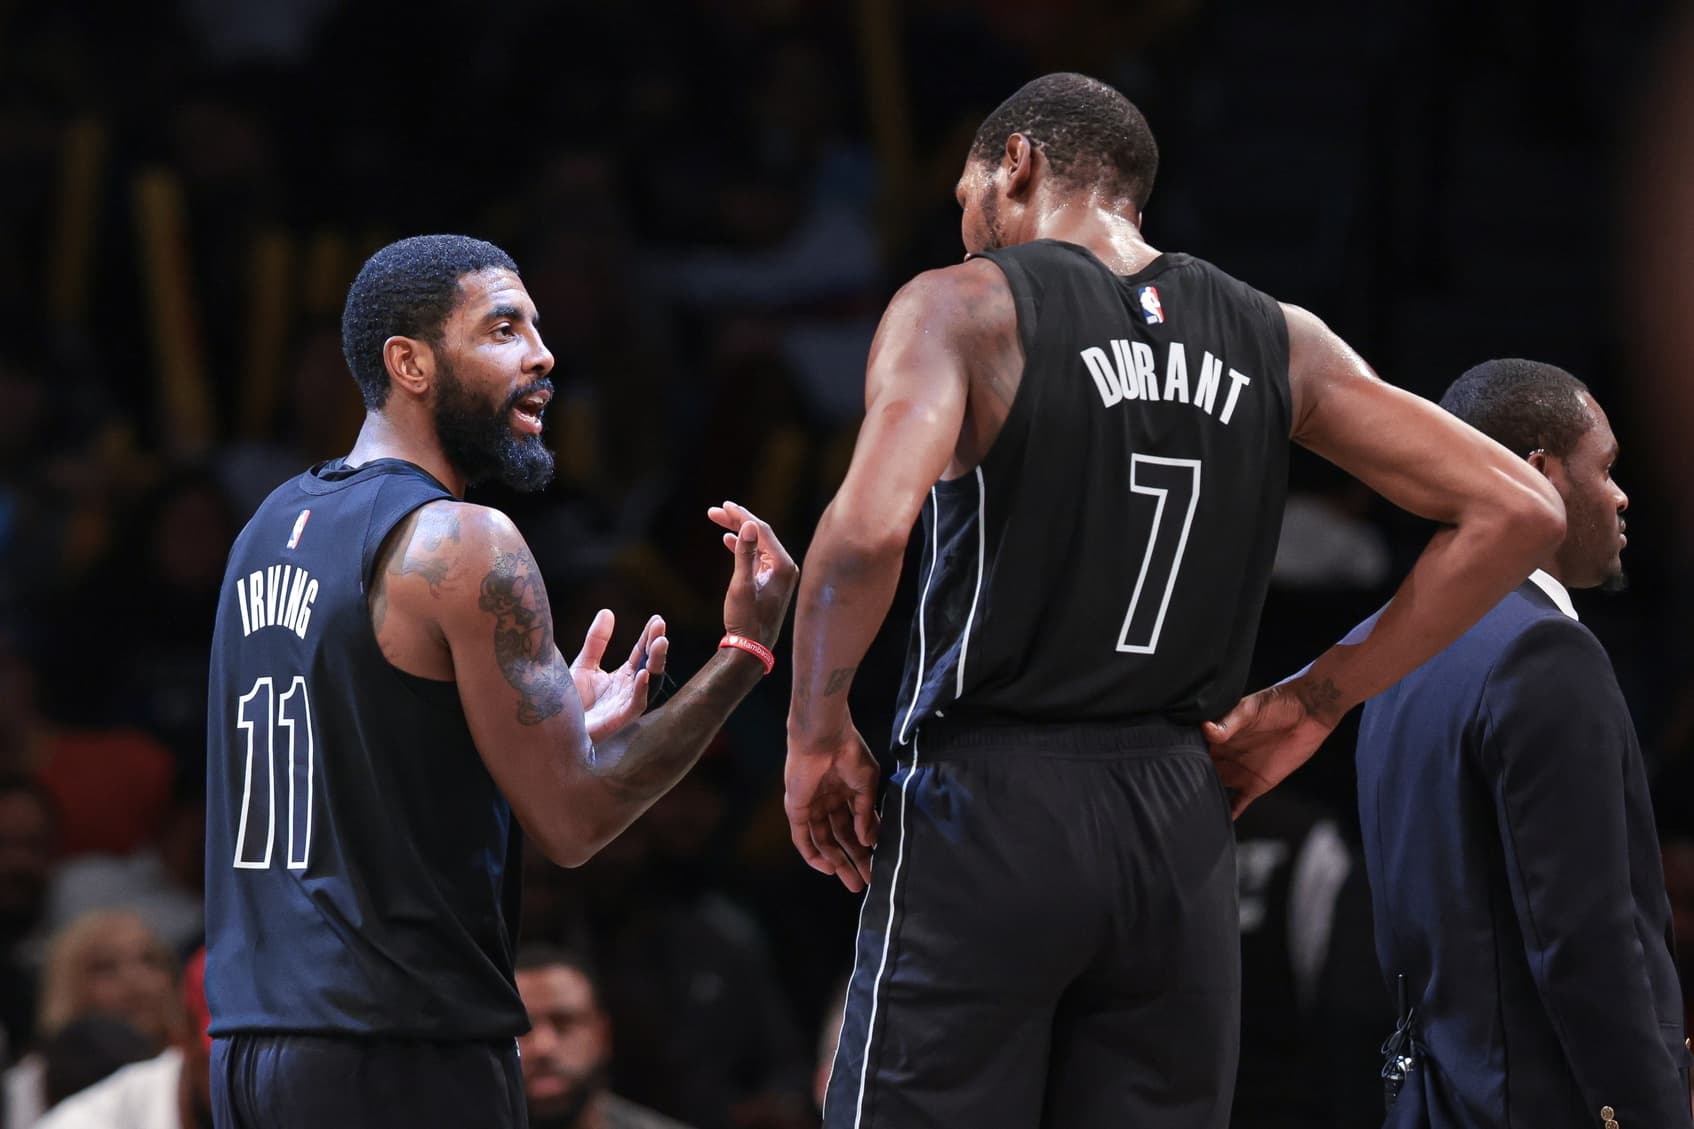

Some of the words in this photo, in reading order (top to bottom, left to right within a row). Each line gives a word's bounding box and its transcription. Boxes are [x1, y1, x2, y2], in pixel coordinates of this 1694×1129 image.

[1080, 339, 1250, 425] DURANT
[236, 564, 319, 640] IRVING
[1115, 453, 1201, 655] 7
[233, 676, 314, 870] 11
